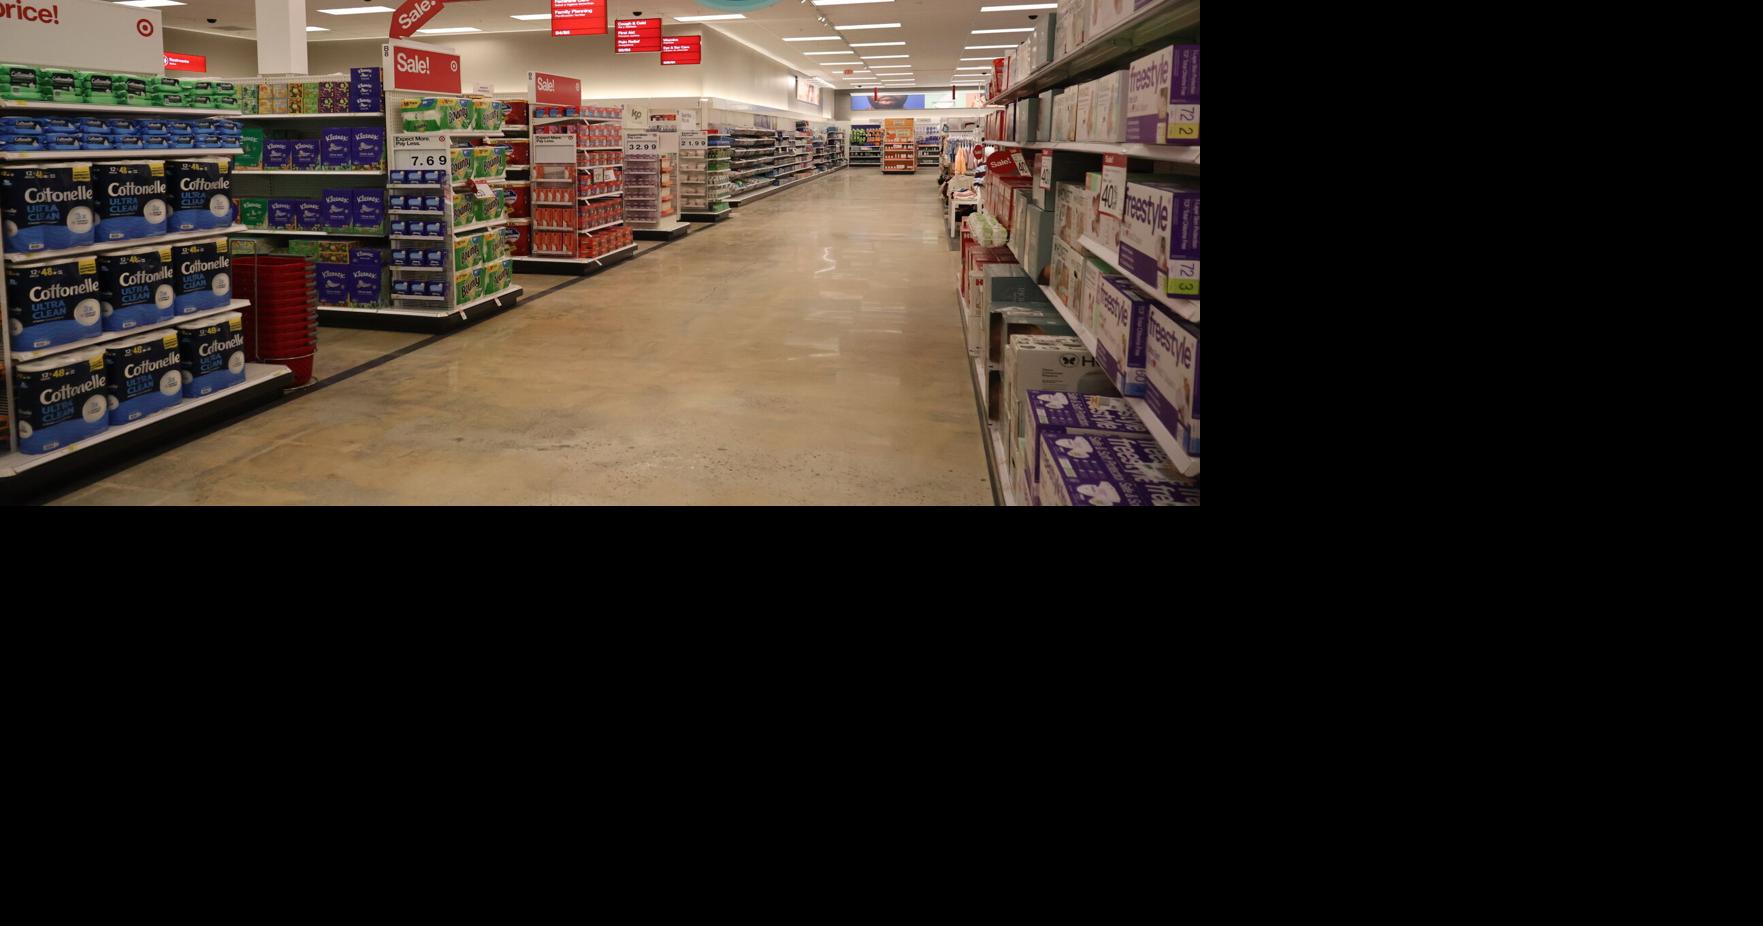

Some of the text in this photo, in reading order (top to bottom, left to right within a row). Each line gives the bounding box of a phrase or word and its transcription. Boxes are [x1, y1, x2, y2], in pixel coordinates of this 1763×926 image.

[398, 0, 436, 29] Sale
[397, 52, 430, 74] Sale!
[1129, 54, 1169, 95] freestyle
[537, 77, 555, 92] Sale!
[1180, 107, 1195, 121] 72
[1179, 127, 1194, 135] 2
[411, 155, 447, 167] 7.69
[990, 157, 1012, 168] Sale!
[108, 180, 167, 197] Cottonelle
[180, 177, 230, 191] Cottonelle
[24, 185, 93, 204] Cottonelle
[110, 197, 138, 206] ULTRA
[1102, 184, 1114, 208] 40
[110, 205, 138, 213] CLEAN
[41, 267, 54, 277] 48
[181, 256, 230, 275] Cottonelle
[1180, 263, 1195, 278] 72
[119, 265, 174, 287] Cottonelle
[29, 277, 100, 303] Cottonelle
[121, 285, 150, 296] ULTRA
[1178, 283, 1194, 291] 3
[122, 292, 151, 303] CLEAN
[1100, 283, 1128, 327] freestyle
[31, 300, 65, 312] ULTRA
[32, 308, 67, 320] CLEAN
[1149, 310, 1192, 369] freestyle
[124, 351, 180, 379] Cottonelle
[52, 369, 65, 378] 48
[39, 374, 106, 405] Cottonelle
